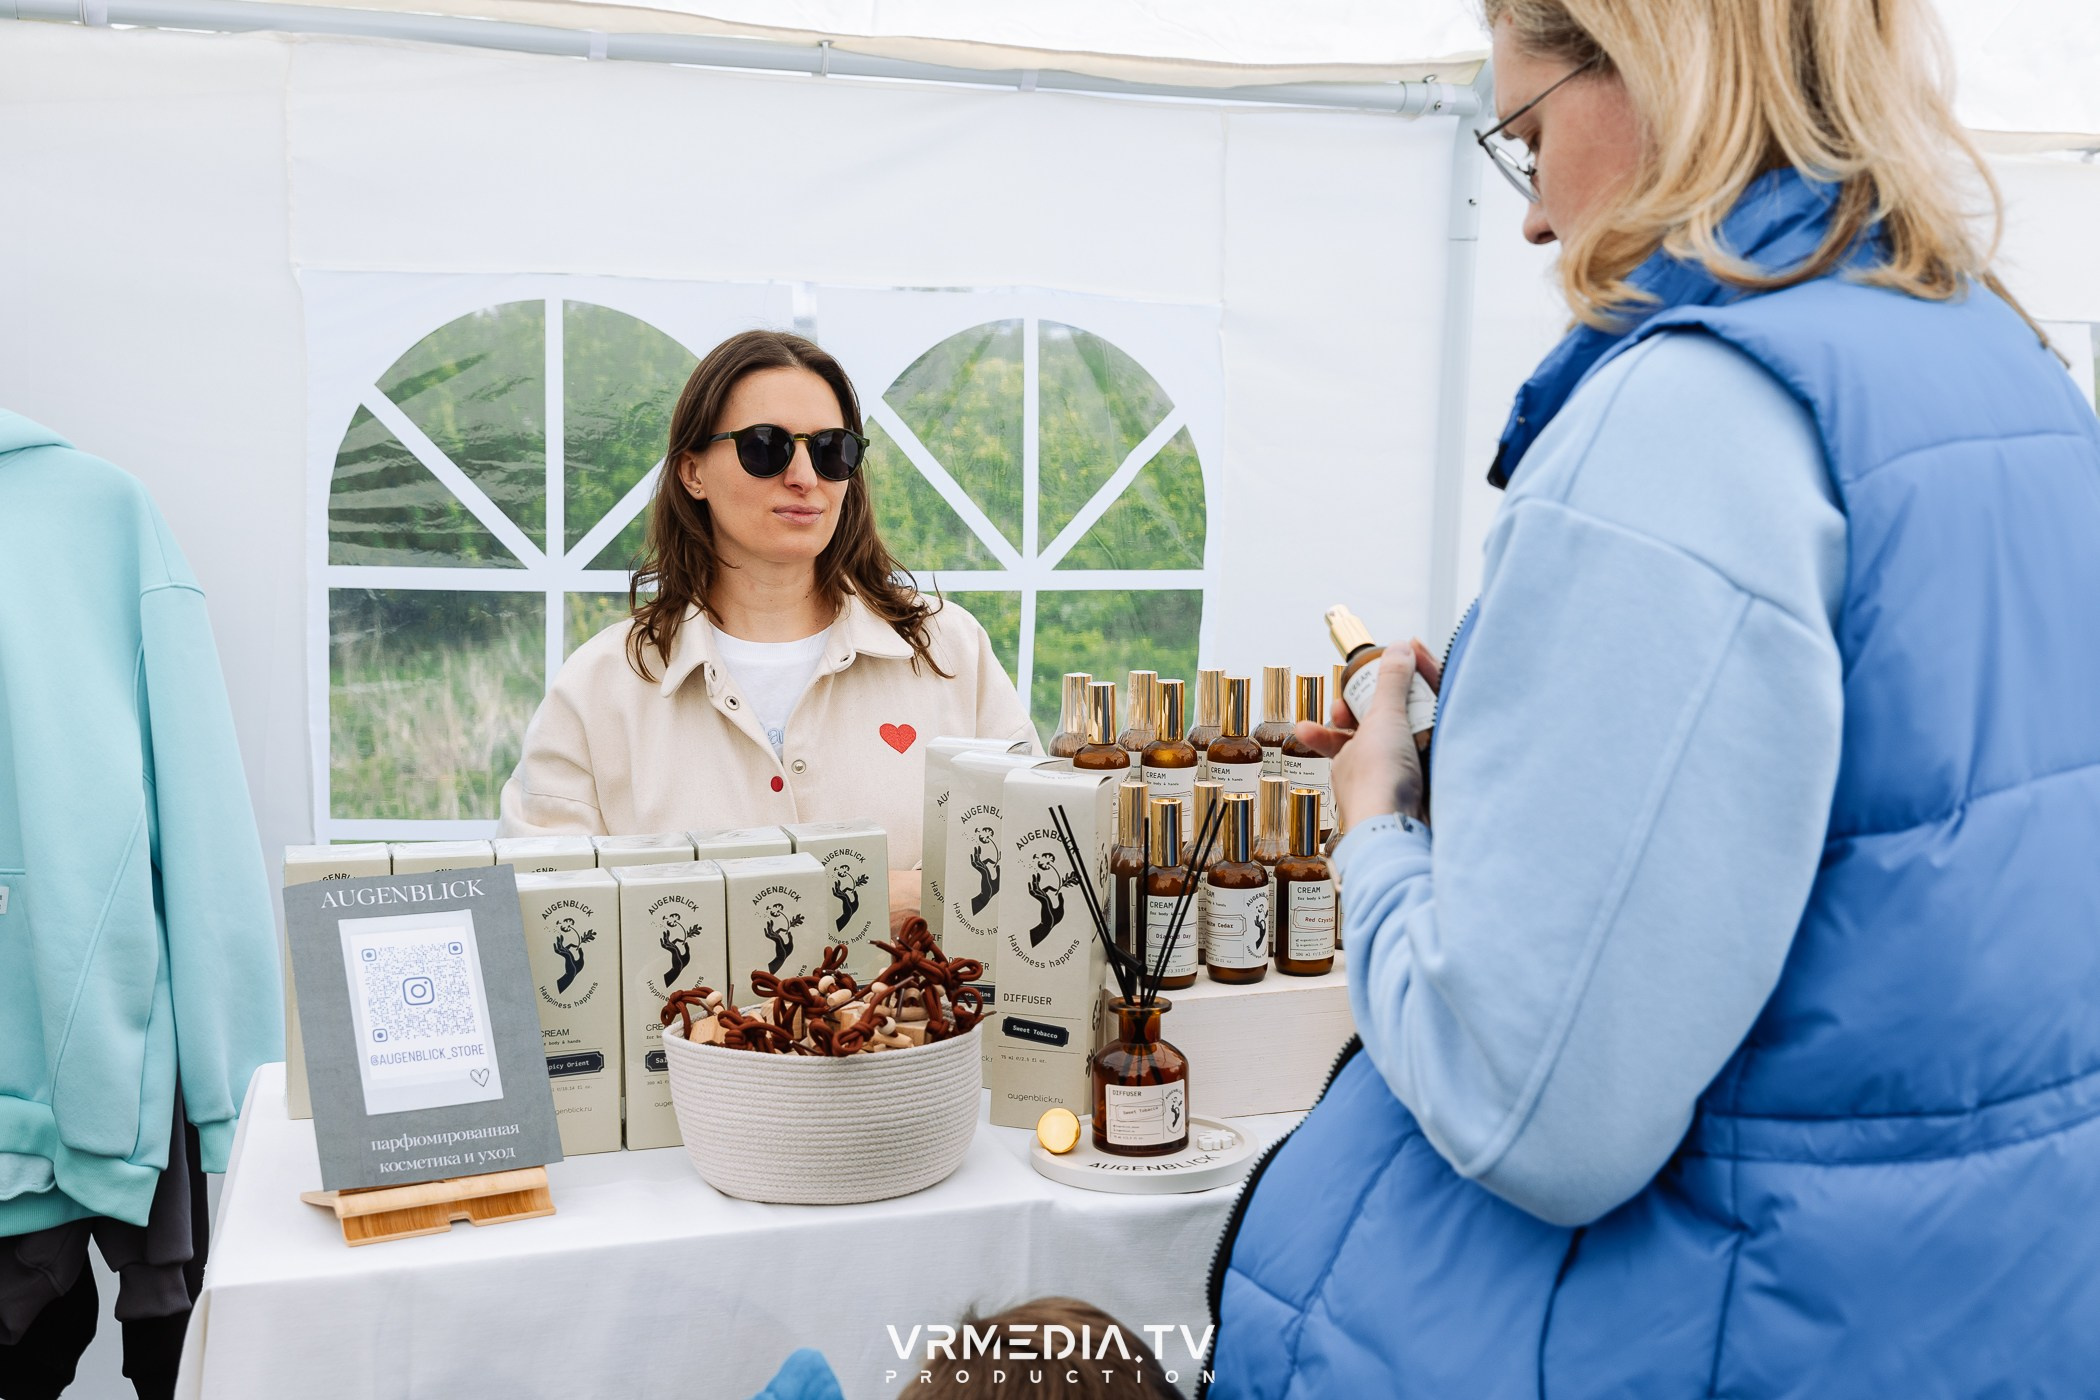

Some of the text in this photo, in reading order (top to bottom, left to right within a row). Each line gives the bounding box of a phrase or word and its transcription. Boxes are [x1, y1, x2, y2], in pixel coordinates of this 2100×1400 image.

[1210, 766, 1231, 775] CREAM
[1284, 760, 1302, 769] CREAM
[1145, 771, 1167, 779] CREAM
[320, 878, 486, 910] AUGENBLICK
[751, 885, 802, 907] AUGENBLICK
[1297, 886, 1321, 894] CREAM
[541, 899, 594, 920] AUGENBLICK
[648, 895, 700, 916] AUGENBLICK
[1149, 901, 1174, 909] CREAM
[952, 902, 985, 936] Happiness
[850, 920, 872, 944] happens
[1182, 932, 1192, 940] Day
[1007, 934, 1046, 969] Happiness
[1049, 938, 1080, 969] happens
[539, 981, 599, 1009] Happiness happens
[1003, 992, 1053, 1006] DIFFUSER
[1012, 1025, 1058, 1039] Sweet Tobacco
[370, 1043, 485, 1067] @AUGENBLICK_STORE
[547, 1060, 590, 1071] picy Orient
[1007, 1092, 1064, 1105] augenblick.ru
[1112, 1089, 1142, 1097] DIFFUSER
[555, 1106, 593, 1116] genblick.ru
[370, 1123, 520, 1153] парфюмированная
[379, 1147, 516, 1174] косметика и уход
[1088, 1153, 1221, 1172] AUGENBLICK
